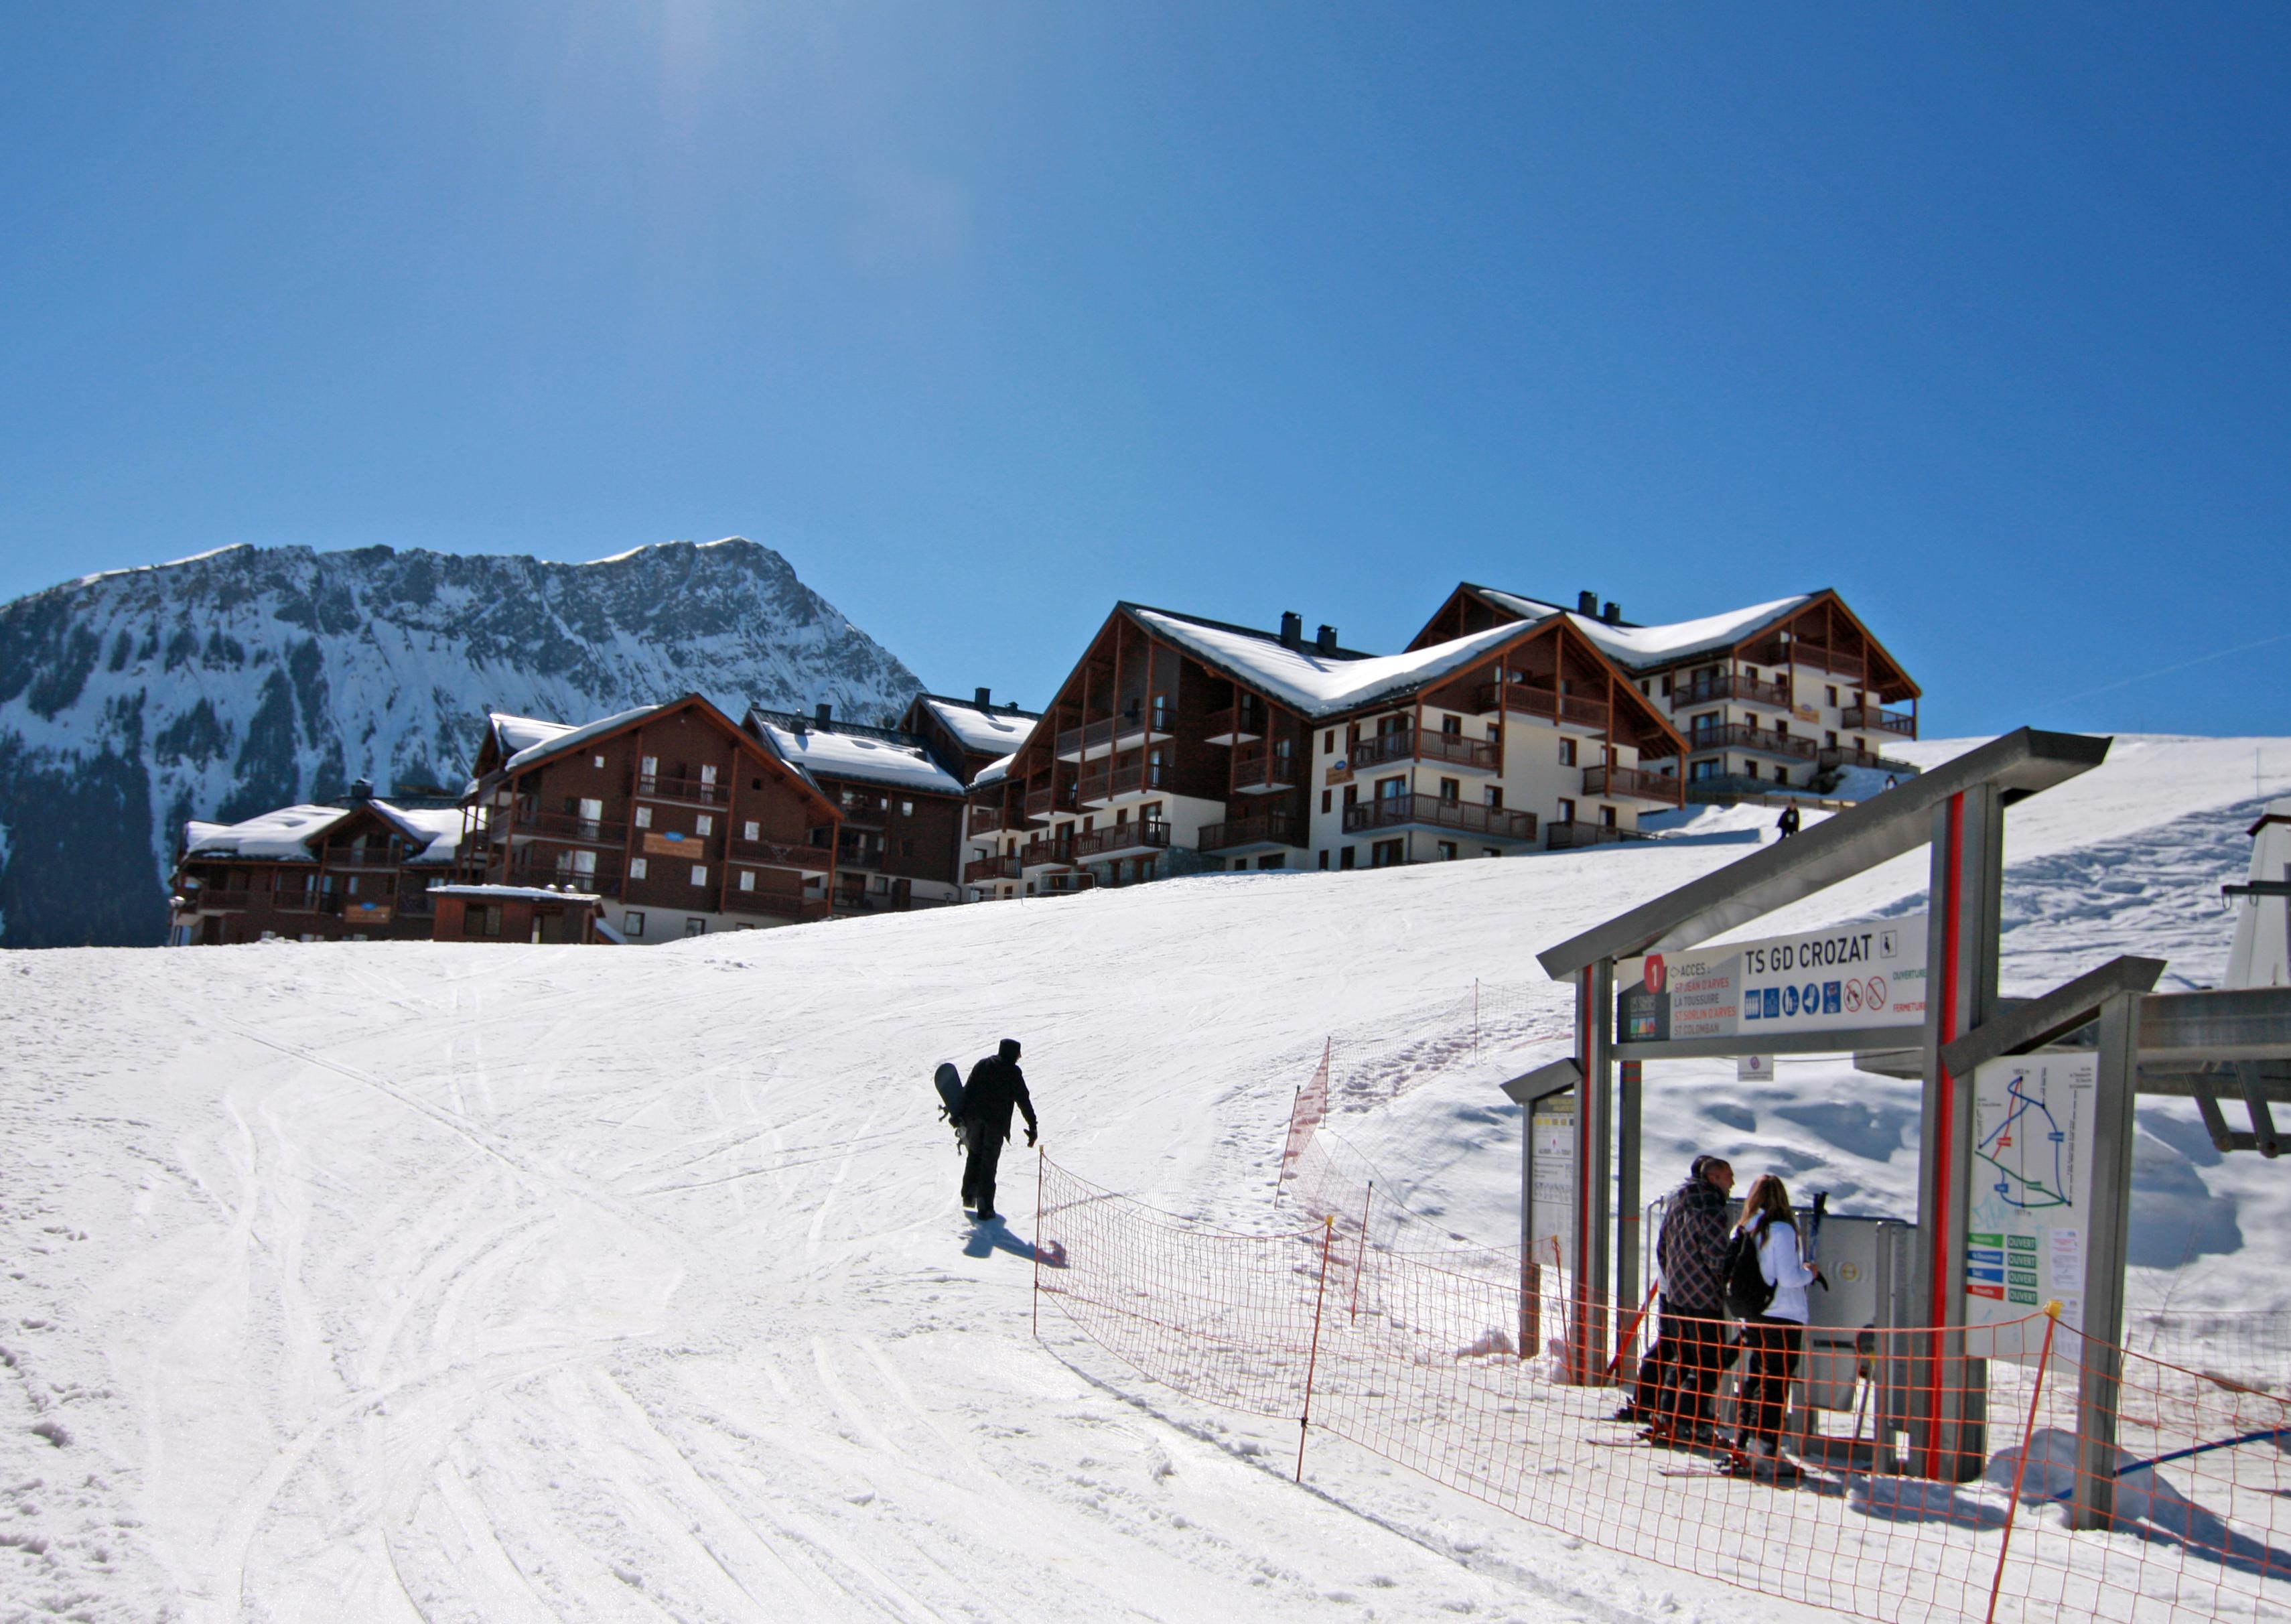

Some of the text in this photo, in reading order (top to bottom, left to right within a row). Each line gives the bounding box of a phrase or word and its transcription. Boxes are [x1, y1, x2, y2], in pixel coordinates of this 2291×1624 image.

[1746, 934, 1872, 974] TS GD CROZAT
[1651, 964, 1657, 987] 1
[2009, 1237, 2035, 1249] OUVERT
[2009, 1254, 2035, 1267] OUVERT
[2010, 1272, 2036, 1285] OUVERT
[2010, 1290, 2036, 1303] OUVERT
